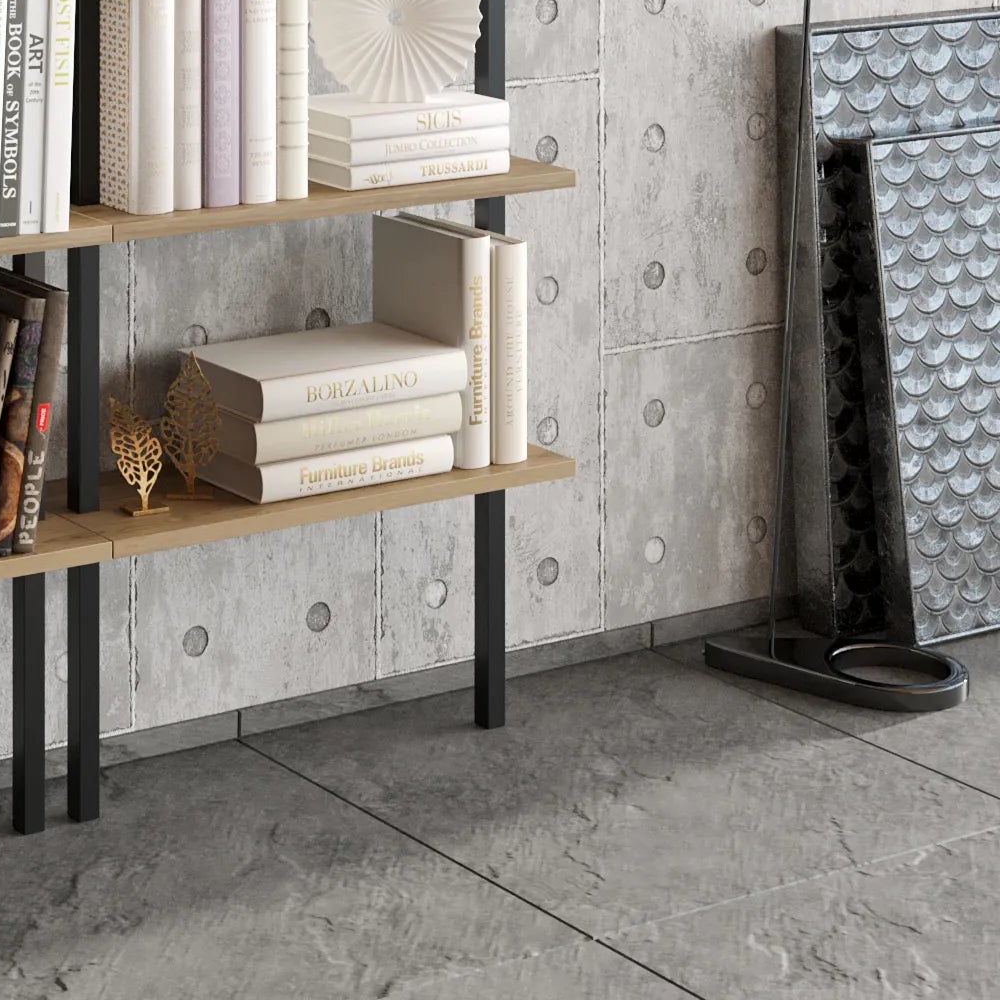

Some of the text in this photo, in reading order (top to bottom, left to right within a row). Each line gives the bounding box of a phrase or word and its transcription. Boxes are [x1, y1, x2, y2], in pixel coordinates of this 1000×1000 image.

[28, 33, 44, 74] ART
[2, 0, 23, 199] THE BOOK OF SYMBOLS
[416, 110, 462, 131] SICIS
[420, 159, 489, 177] TRUSSARDI
[468, 275, 483, 426] Furniture Brands
[306, 371, 418, 403] BORZALINO
[372, 429, 417, 443] LONDON
[300, 450, 424, 485] Furniture Brands
[19, 450, 46, 546] PEOPLE
